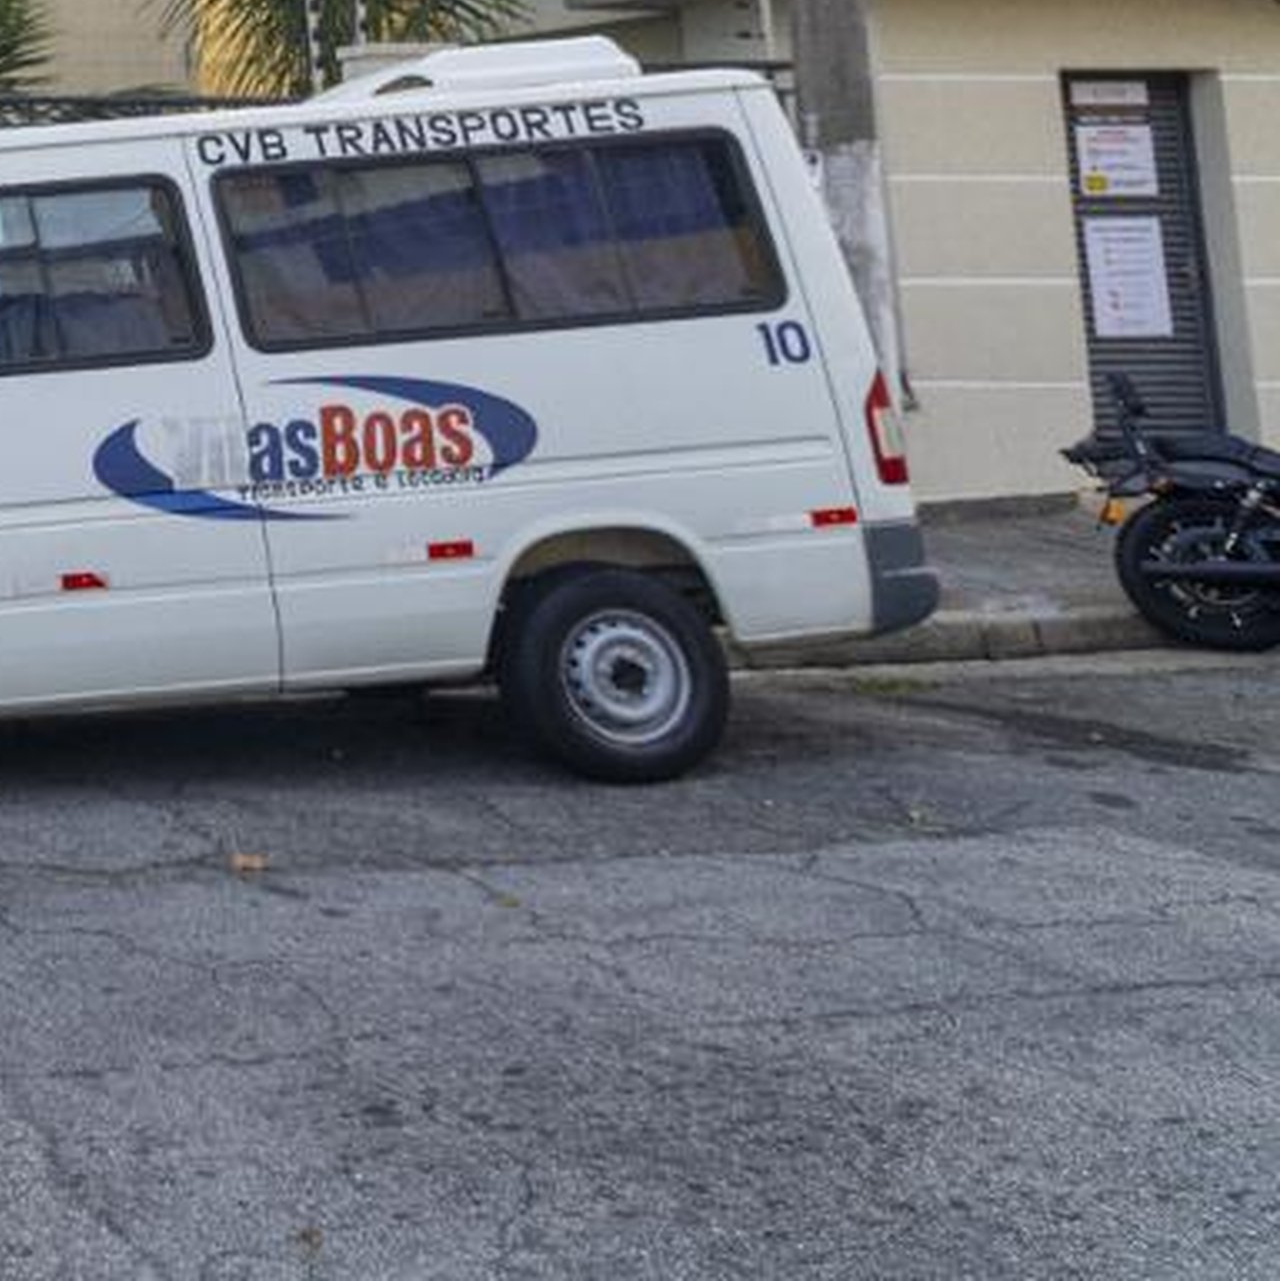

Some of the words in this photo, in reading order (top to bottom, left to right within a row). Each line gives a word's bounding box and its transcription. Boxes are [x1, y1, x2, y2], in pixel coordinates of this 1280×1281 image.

[197, 130, 288, 167] CVB
[304, 99, 645, 159] TRANSPORTES
[755, 319, 811, 367] 10
